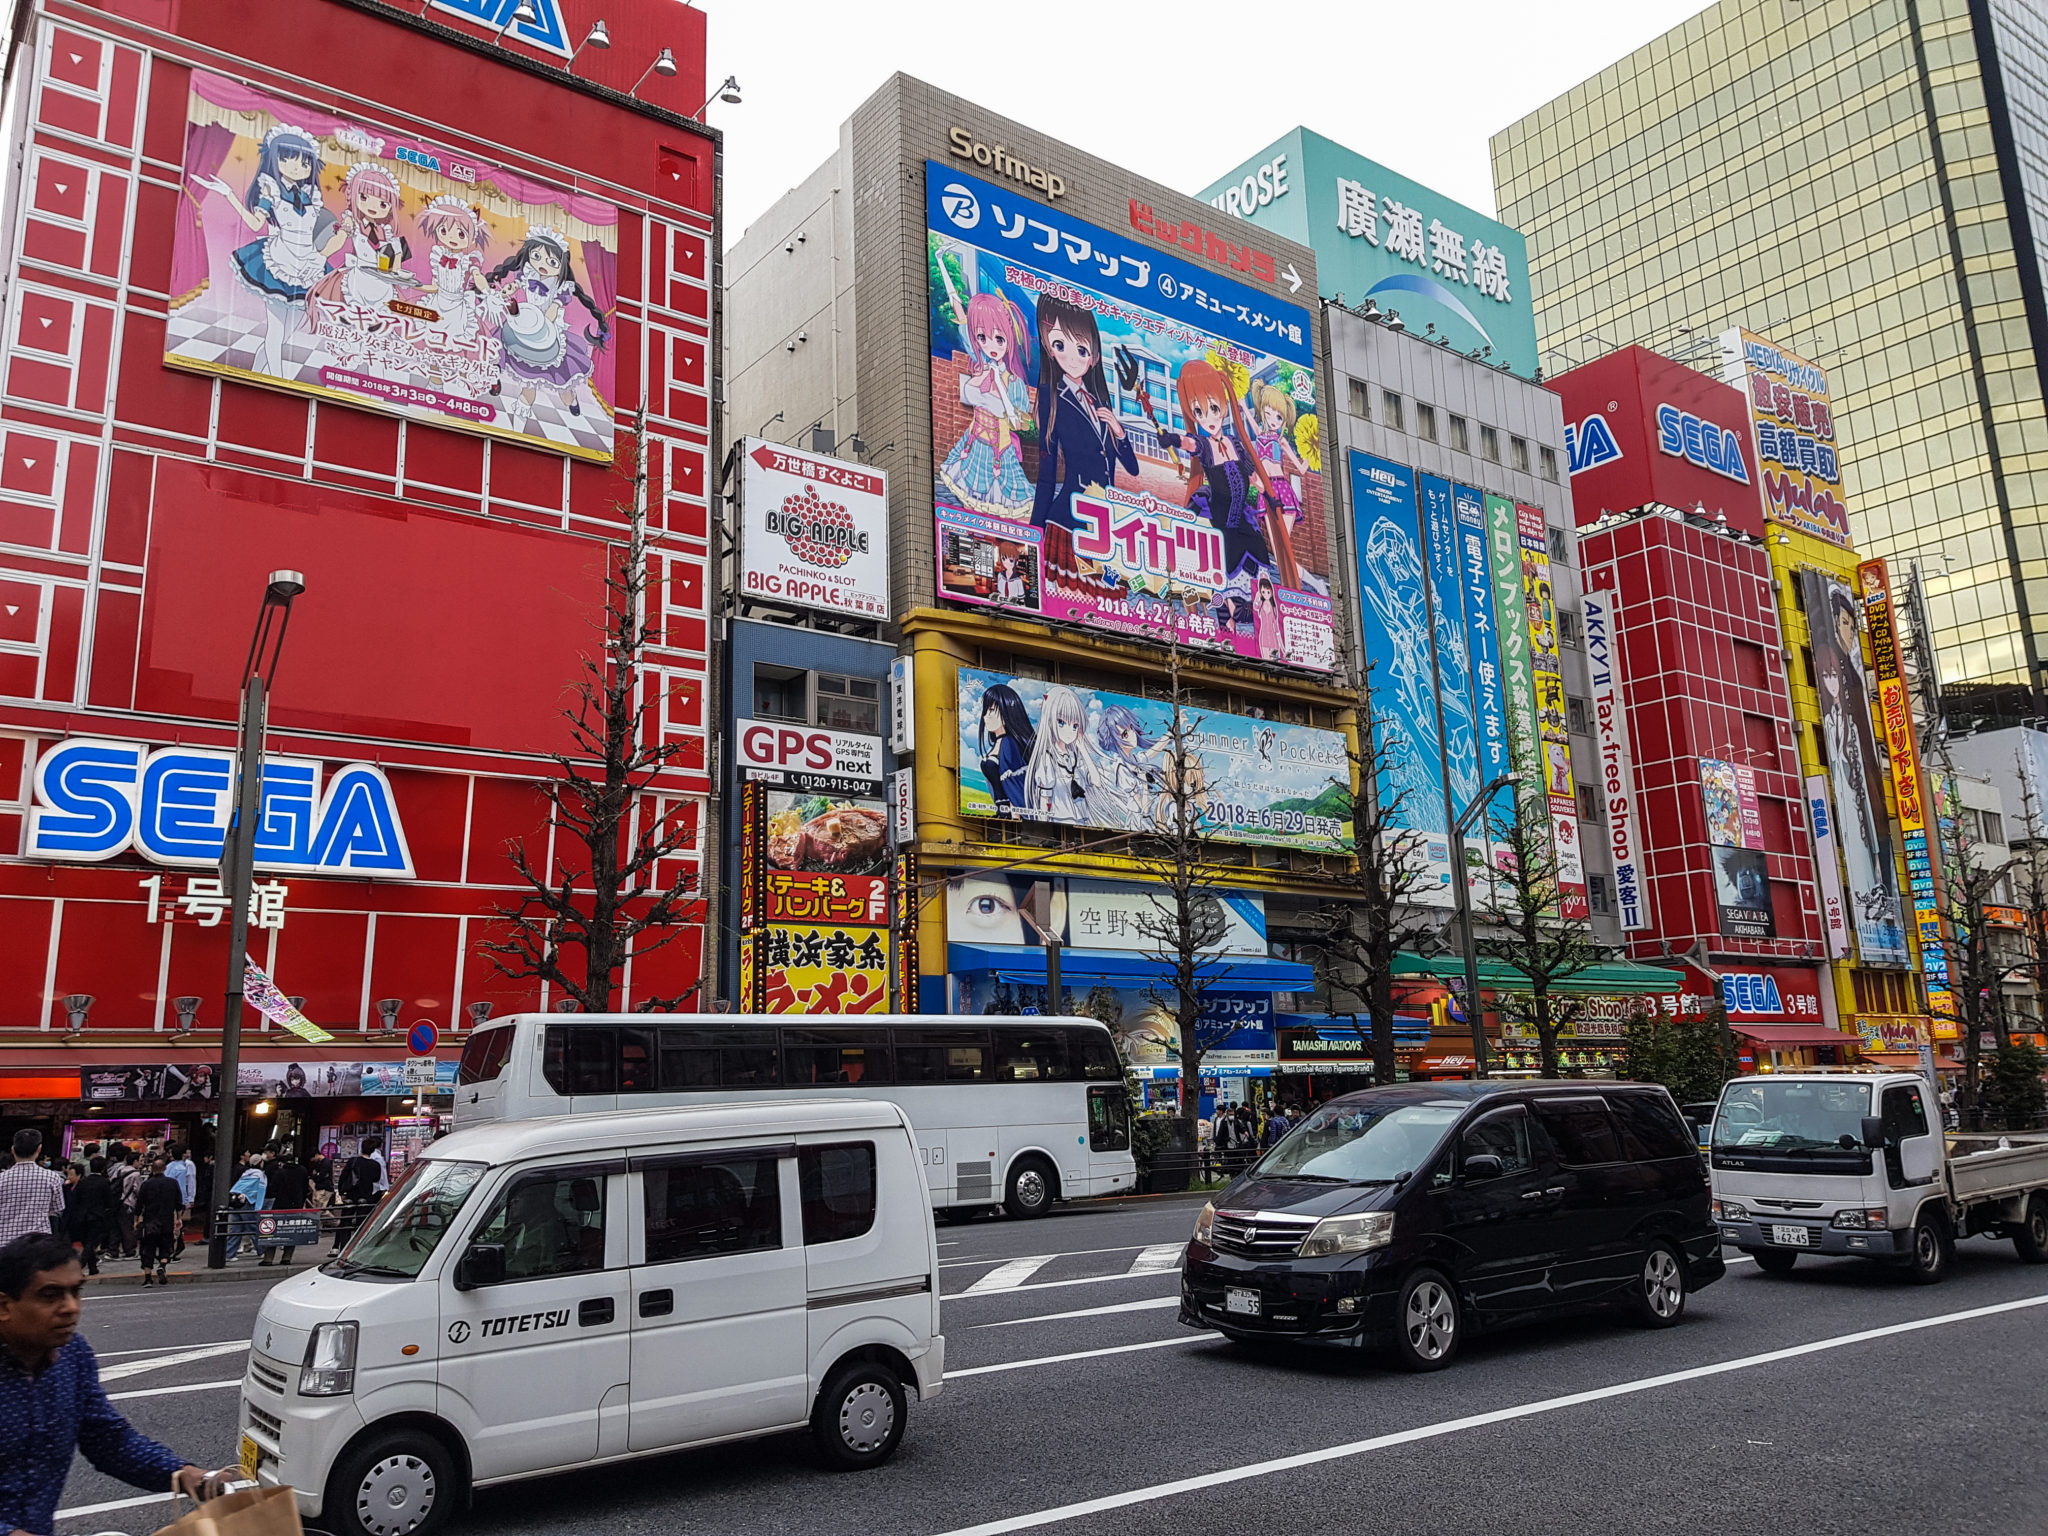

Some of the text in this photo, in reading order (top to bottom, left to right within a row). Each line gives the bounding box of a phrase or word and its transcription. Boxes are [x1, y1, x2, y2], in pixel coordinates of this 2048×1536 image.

[395, 146, 441, 172] SEGA
[949, 127, 1067, 200] Sofmap
[1128, 197, 1276, 283] ビックカメラ
[991, 203, 1151, 289] ソフマップ
[1179, 281, 1303, 346] アミューズメント館
[394, 302, 433, 319] セガ限定
[320, 301, 499, 361] マギアレコード
[363, 351, 459, 383] キャンペーン
[1744, 340, 1827, 394] MEDIAリサイクル
[1751, 372, 1834, 442] 激安販売
[1656, 402, 1751, 486] SEGA
[1756, 420, 1840, 484] 高額買取
[772, 452, 872, 491] 万世橋すぐよこ!
[1370, 467, 1396, 488] Hey
[766, 510, 869, 555] BIG APPLE
[1438, 492, 1454, 577] ゲームセンターを
[1778, 509, 1803, 527] ムーラン
[1803, 520, 1822, 534] AKIBA
[1076, 499, 1224, 586] コイカツ!
[747, 570, 783, 593] BIG
[778, 563, 827, 581] PACHINKO
[833, 576, 857, 587] SLOT
[1179, 569, 1212, 585] koikatu
[843, 598, 886, 615] 秋葉原店
[1868, 603, 1886, 614] DVD
[1584, 599, 1610, 670] AKKY
[1875, 629, 1888, 638] CD
[1875, 646, 1894, 655] アニメ
[743, 725, 833, 770] GPS
[835, 738, 873, 751] リアルタイム
[1185, 725, 1340, 766] Summer Pockets
[1597, 689, 1621, 793] Tax-free
[800, 775, 872, 791] 0120-915-047
[835, 760, 872, 775] next
[32, 745, 411, 874] SEGA
[899, 783, 908, 827] GPS
[1206, 801, 1342, 838] 2018年6月29日発売
[1608, 797, 1629, 861] Shop
[743, 783, 753, 914] ステーキ&ハンバーグ
[1811, 798, 1842, 930] SEGA 3号館
[138, 874, 288, 930] 1号館
[774, 896, 866, 919] ハンバーグ
[1726, 908, 1744, 920] SEGA
[741, 914, 754, 929] 2F
[1734, 924, 1766, 936] AKIHABARA
[764, 928, 887, 971] 横浜家系
[766, 968, 888, 1014] ラーメン
[1206, 999, 1270, 1015] ソフマップ
[1587, 996, 1623, 1020] Shop
[1722, 974, 1784, 1013] SEGA
[1786, 993, 1818, 1015] 3号館
[1292, 1040, 1363, 1051] TAMASHII NATIONS
[1440, 1055, 1467, 1067] Hey
[1282, 1065, 1296, 1073] Best
[1296, 1065, 1314, 1074] Global
[1314, 1065, 1332, 1073] Action
[1332, 1065, 1353, 1074] Figures
[480, 1308, 571, 1338] TOTETSU
